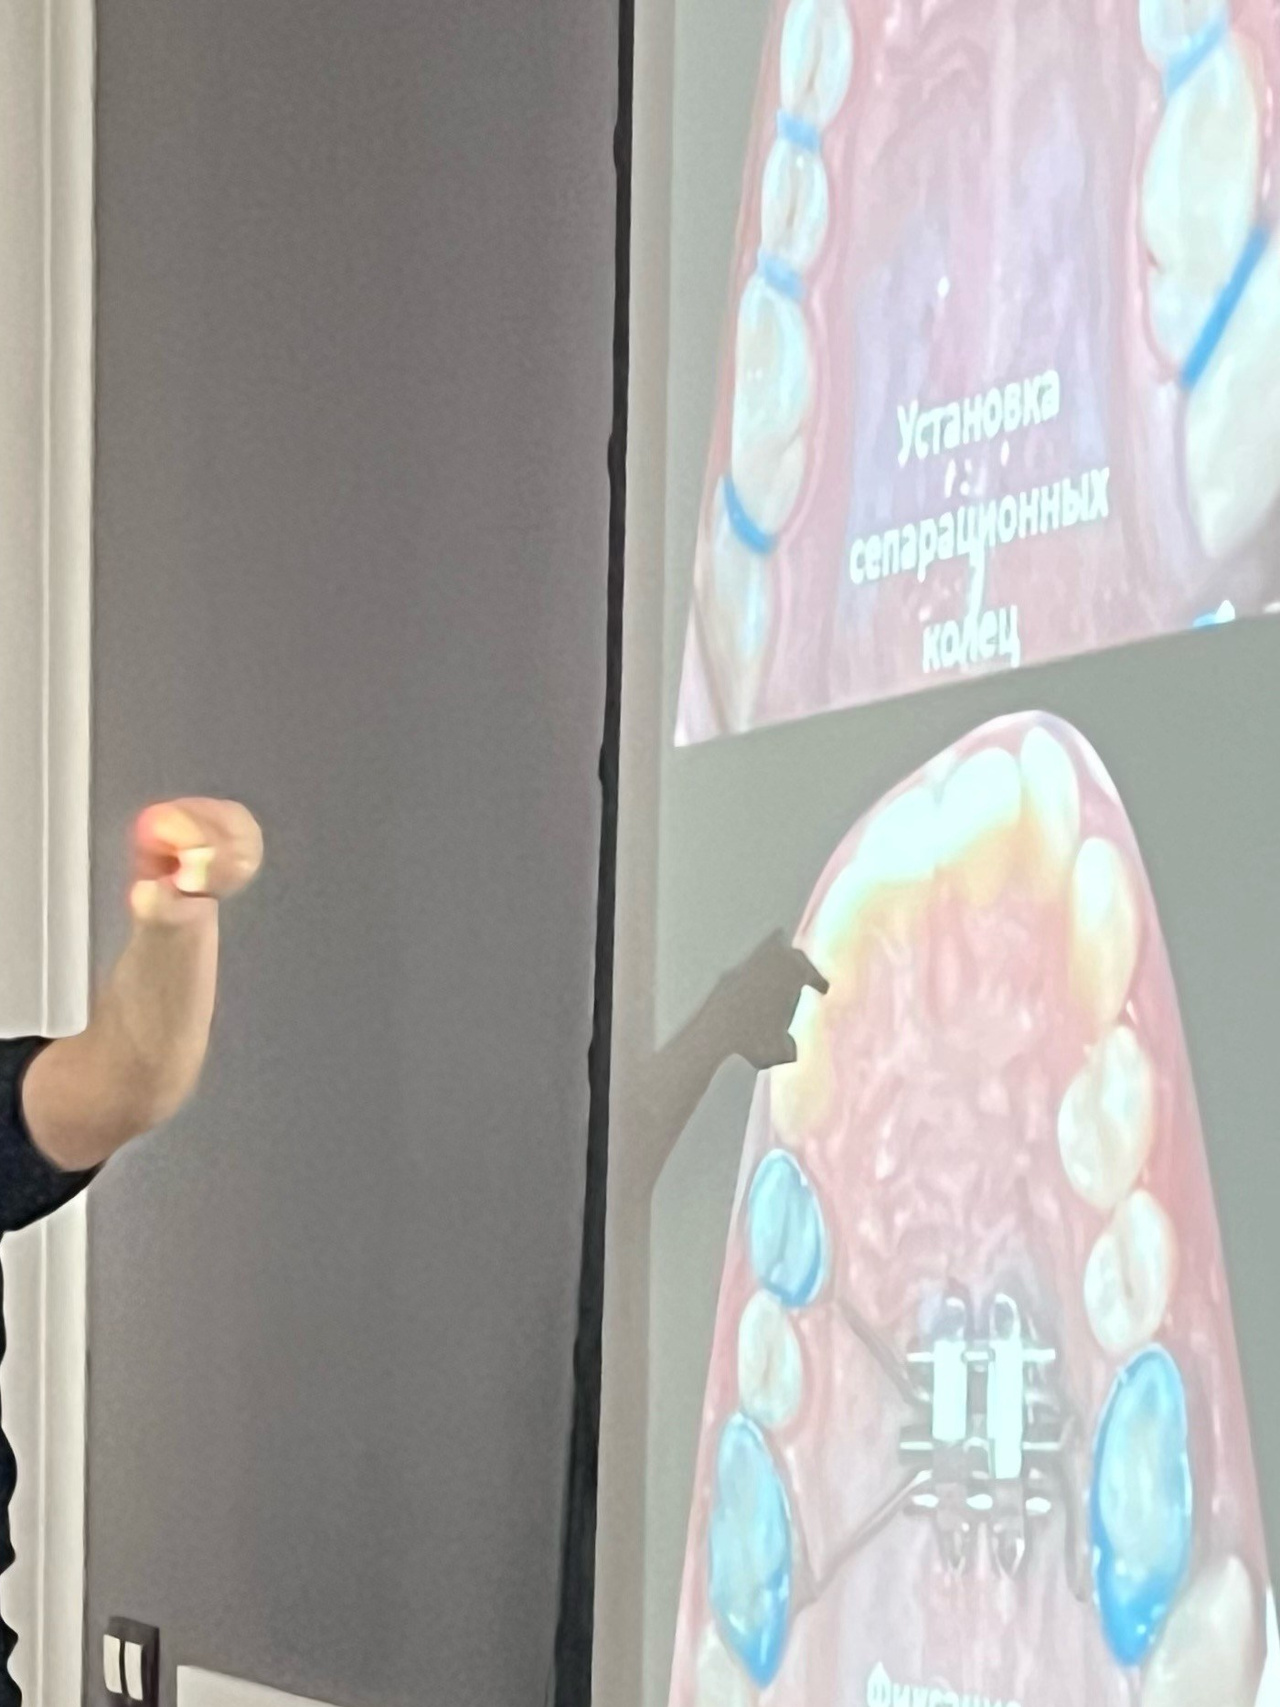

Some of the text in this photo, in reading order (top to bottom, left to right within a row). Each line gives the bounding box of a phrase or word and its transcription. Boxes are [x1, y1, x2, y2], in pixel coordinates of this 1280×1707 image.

[897, 369, 1060, 468] Установка
[849, 467, 1110, 584] сепарационных
[922, 604, 1020, 673] колец
